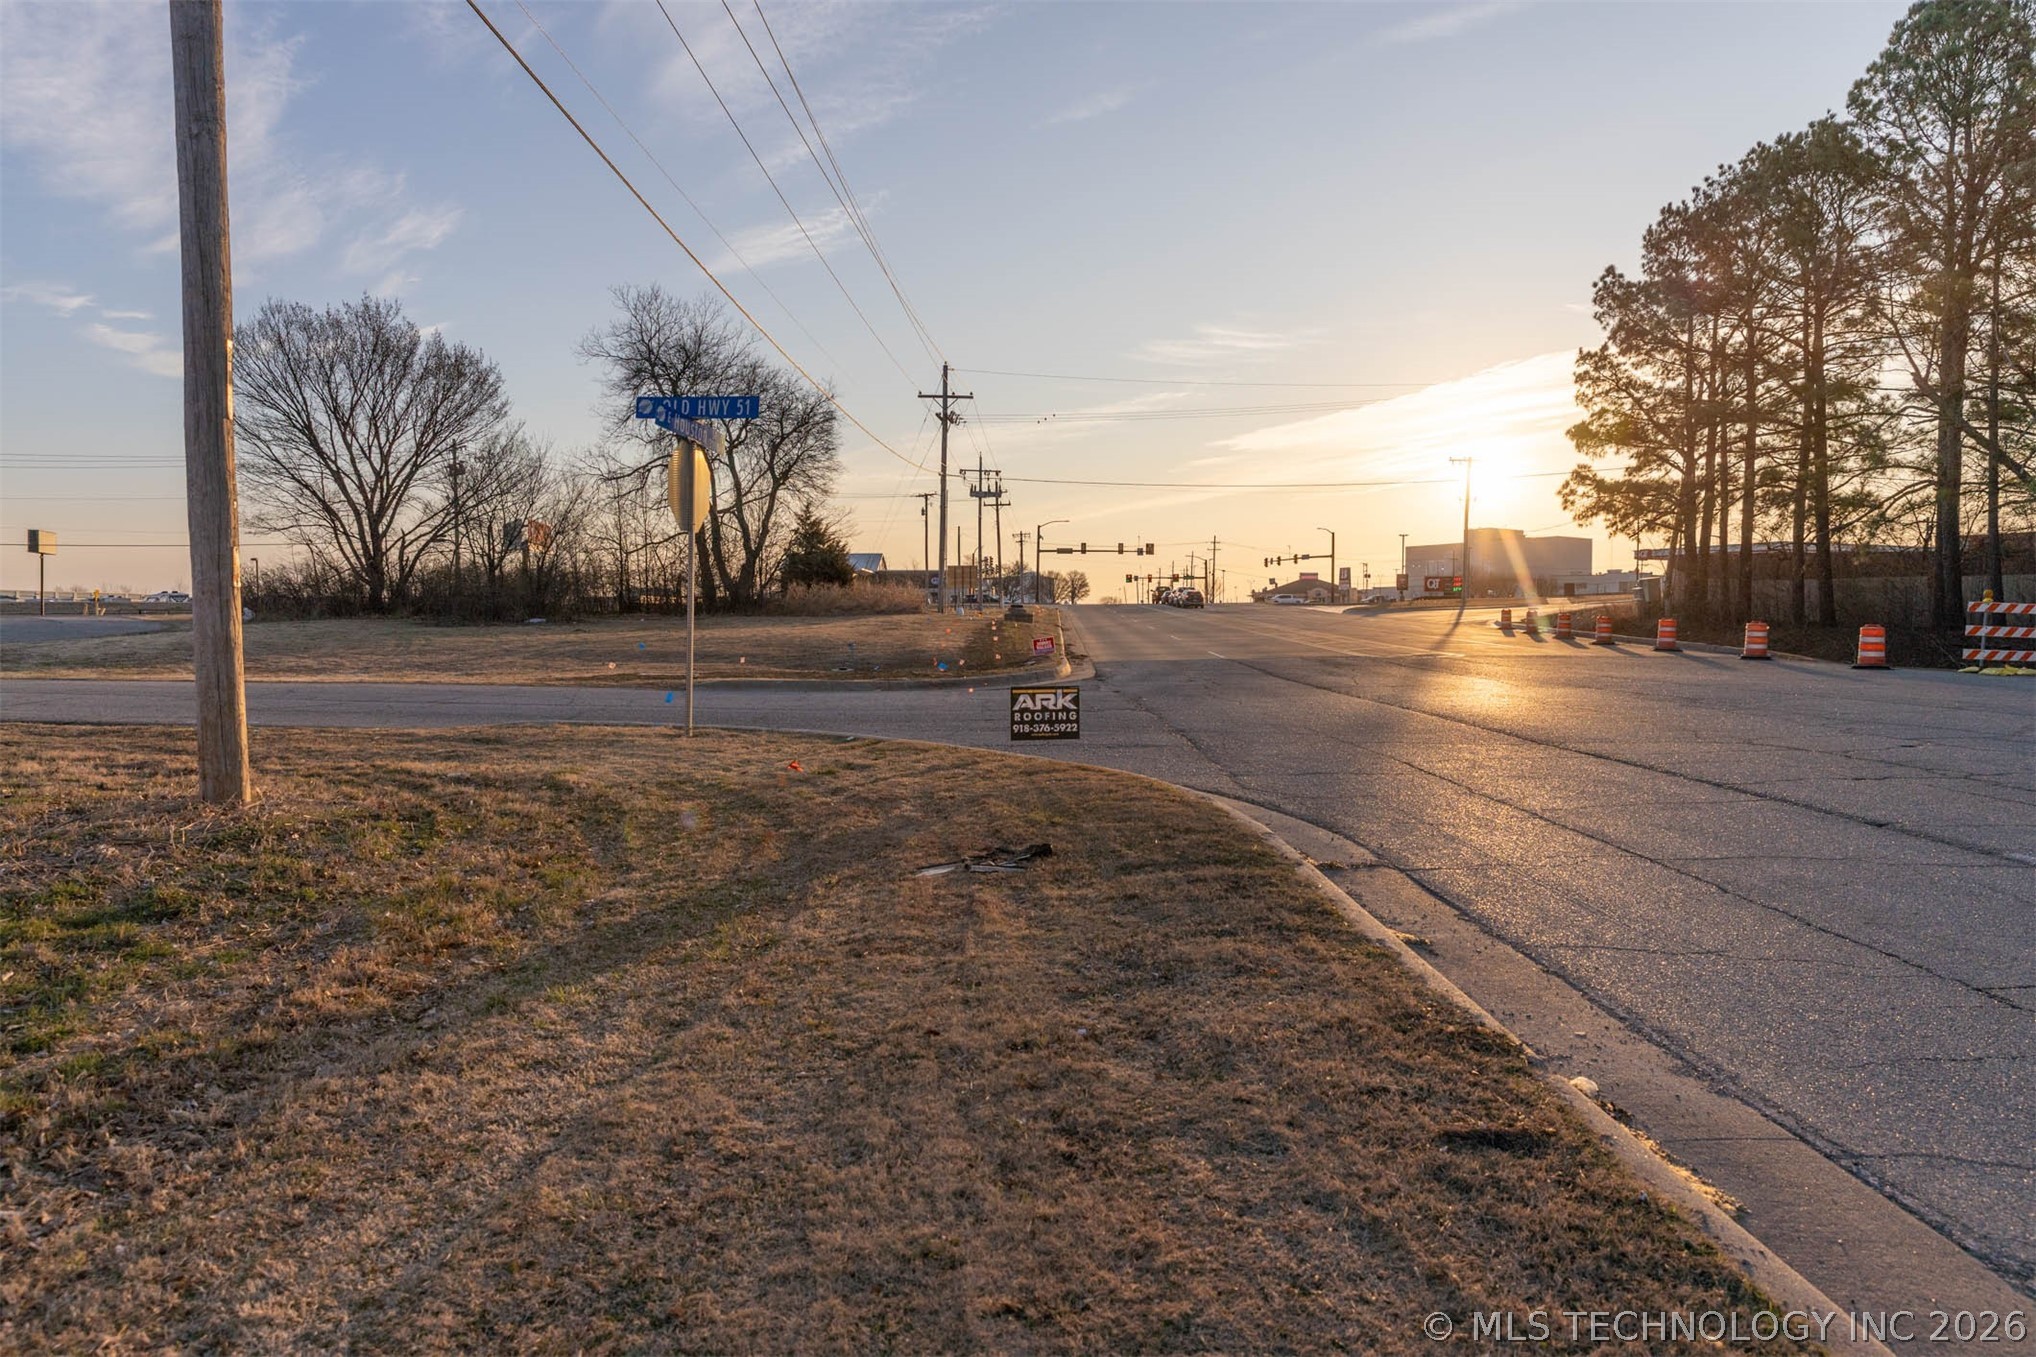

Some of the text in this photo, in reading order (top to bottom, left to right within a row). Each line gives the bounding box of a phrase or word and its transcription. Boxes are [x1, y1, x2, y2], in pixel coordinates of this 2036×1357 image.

[698, 399, 730, 415] HWY
[737, 399, 750, 415] 51
[1427, 578, 1440, 589] QT
[1012, 689, 1078, 710] ARK
[1014, 711, 1077, 721] ROOFING
